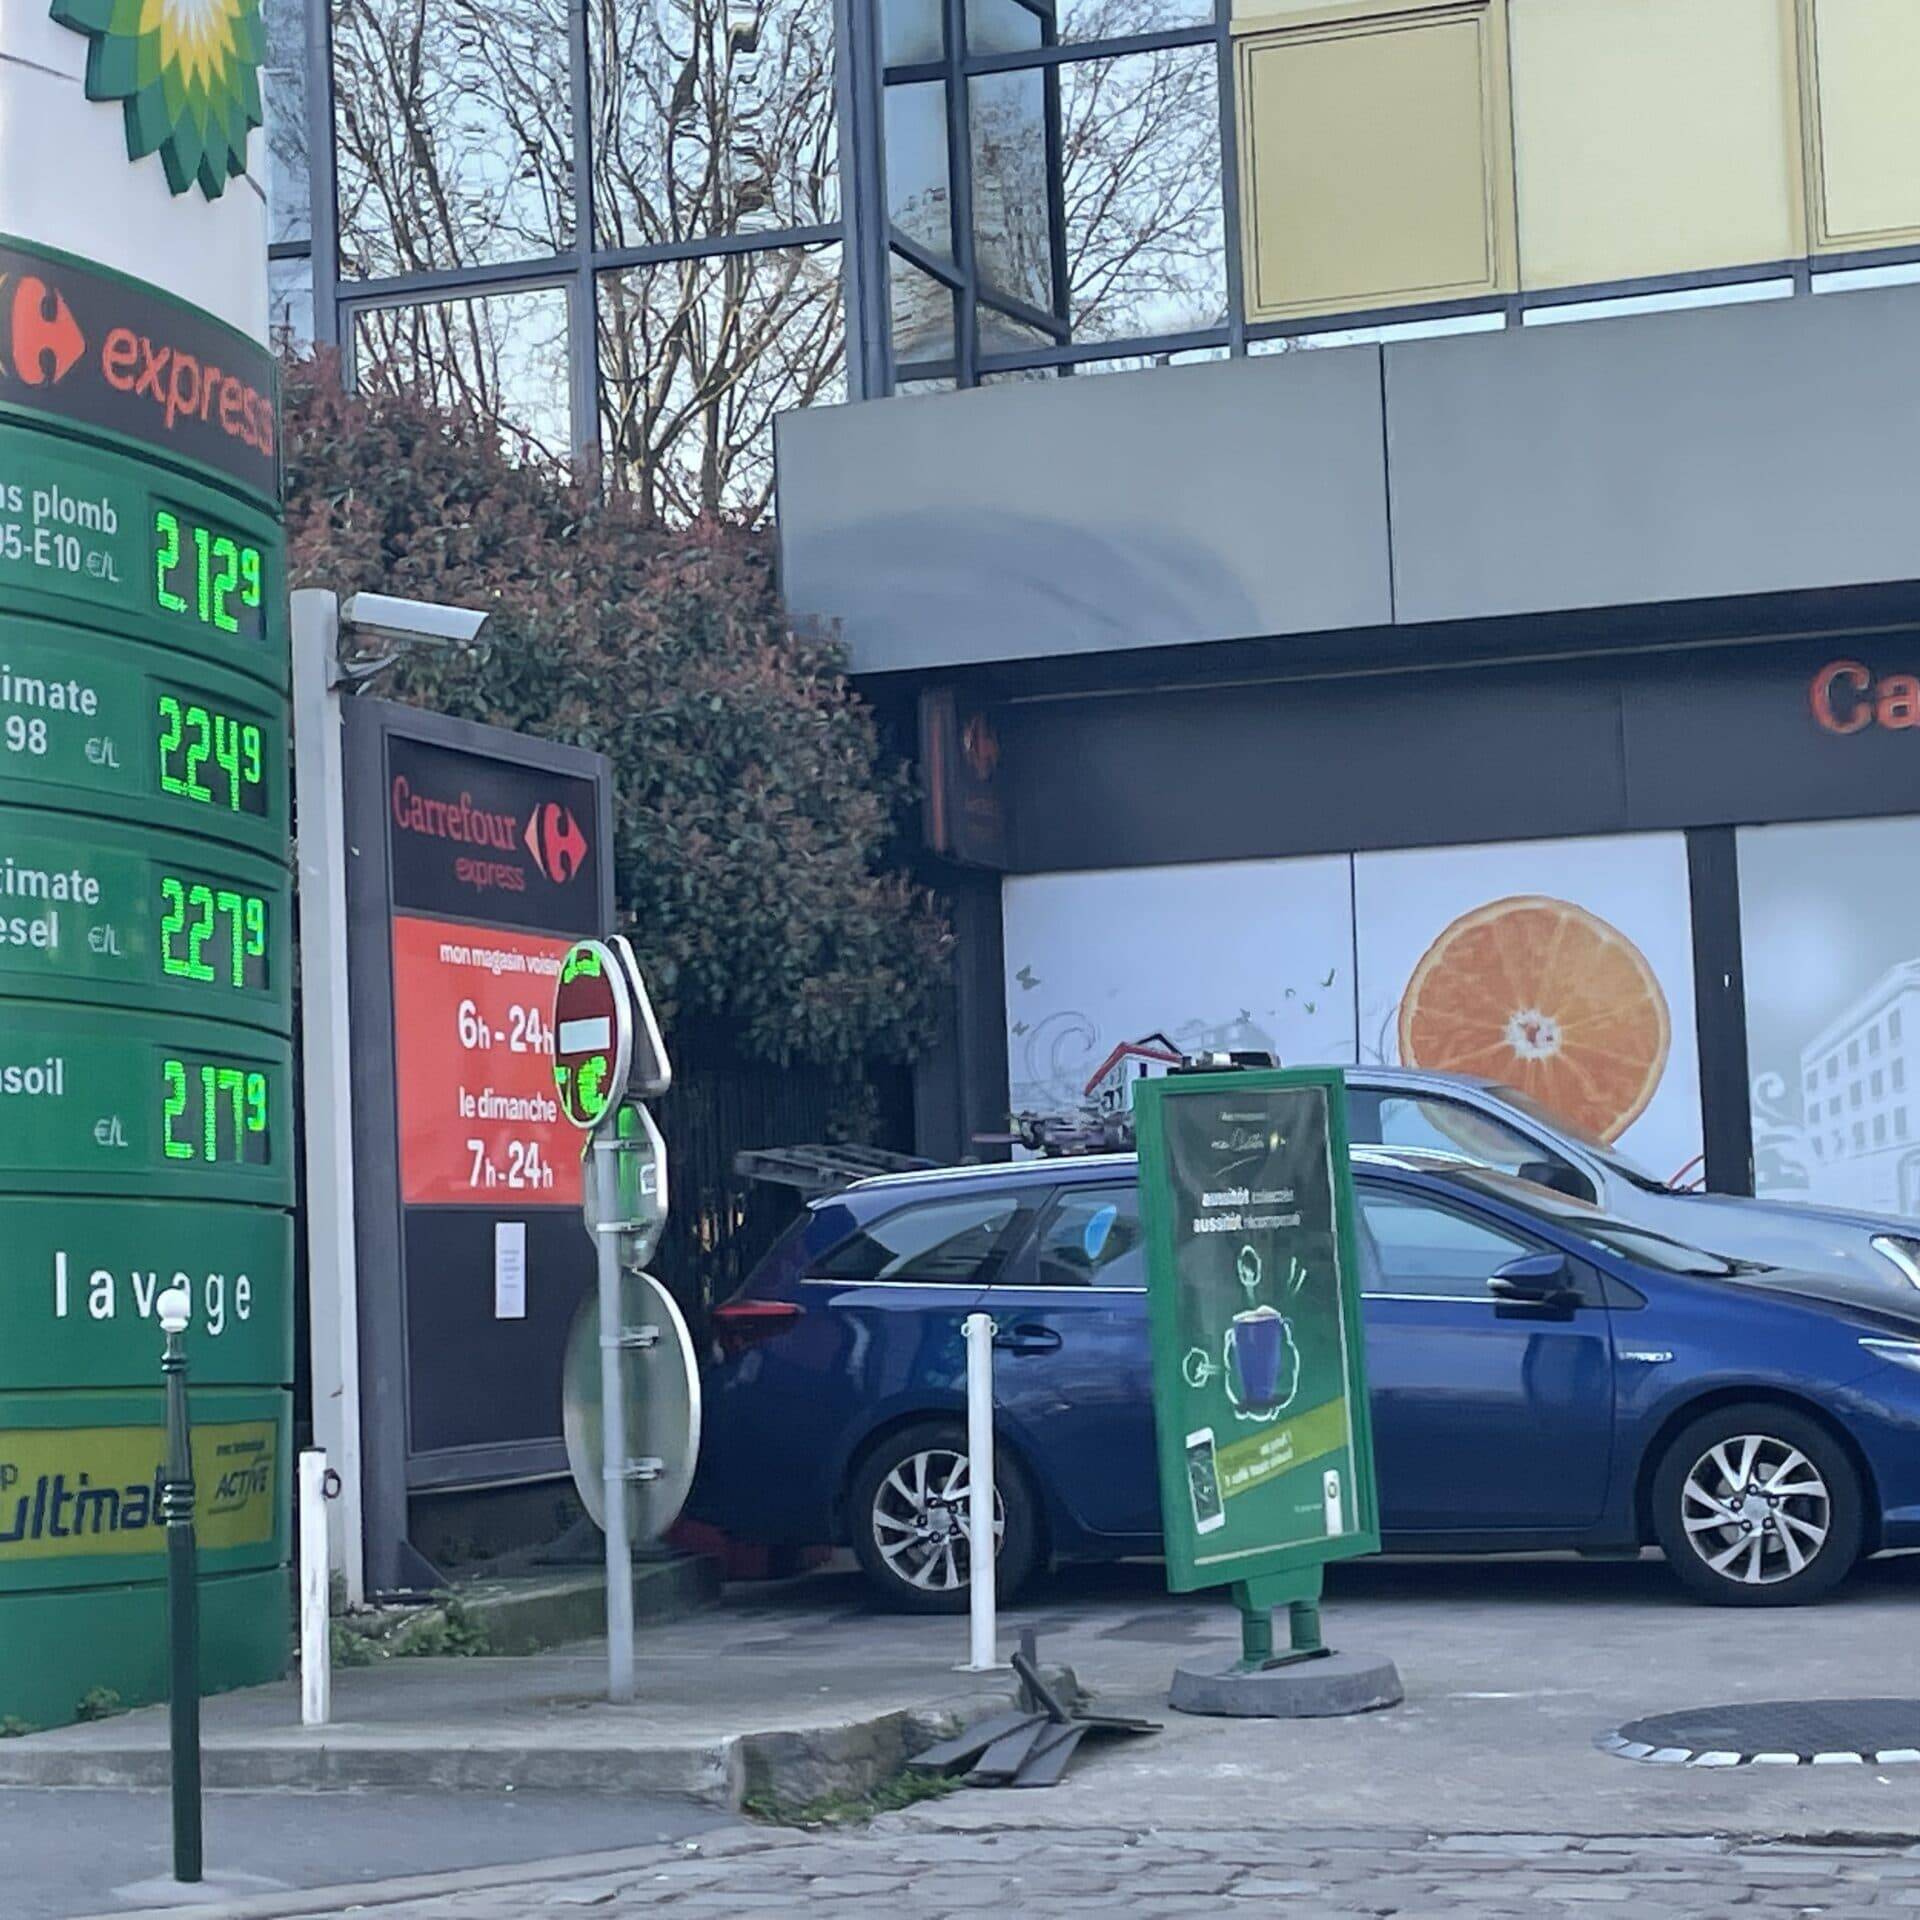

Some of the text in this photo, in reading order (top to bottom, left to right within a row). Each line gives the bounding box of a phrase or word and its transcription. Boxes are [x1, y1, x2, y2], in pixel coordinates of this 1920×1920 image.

[102, 327, 274, 456] express
[33, 484, 117, 535] plomb
[86, 551, 120, 582] €/L
[0, 664, 98, 716] imate
[1810, 659, 1920, 735] Ca
[6, 715, 120, 768] 98 €/L
[393, 775, 517, 851] Carrefour
[0, 857, 99, 905] imate
[455, 857, 526, 893] express
[87, 924, 121, 955] €/L
[439, 944, 471, 966] mon
[472, 948, 526, 975] magasin
[0, 1057, 64, 1095] soil
[459, 1086, 557, 1122] le dimanche
[94, 1115, 128, 1147] €/L
[0, 1464, 170, 1543] ltimat
[215, 1466, 269, 1499] ACTIVE
